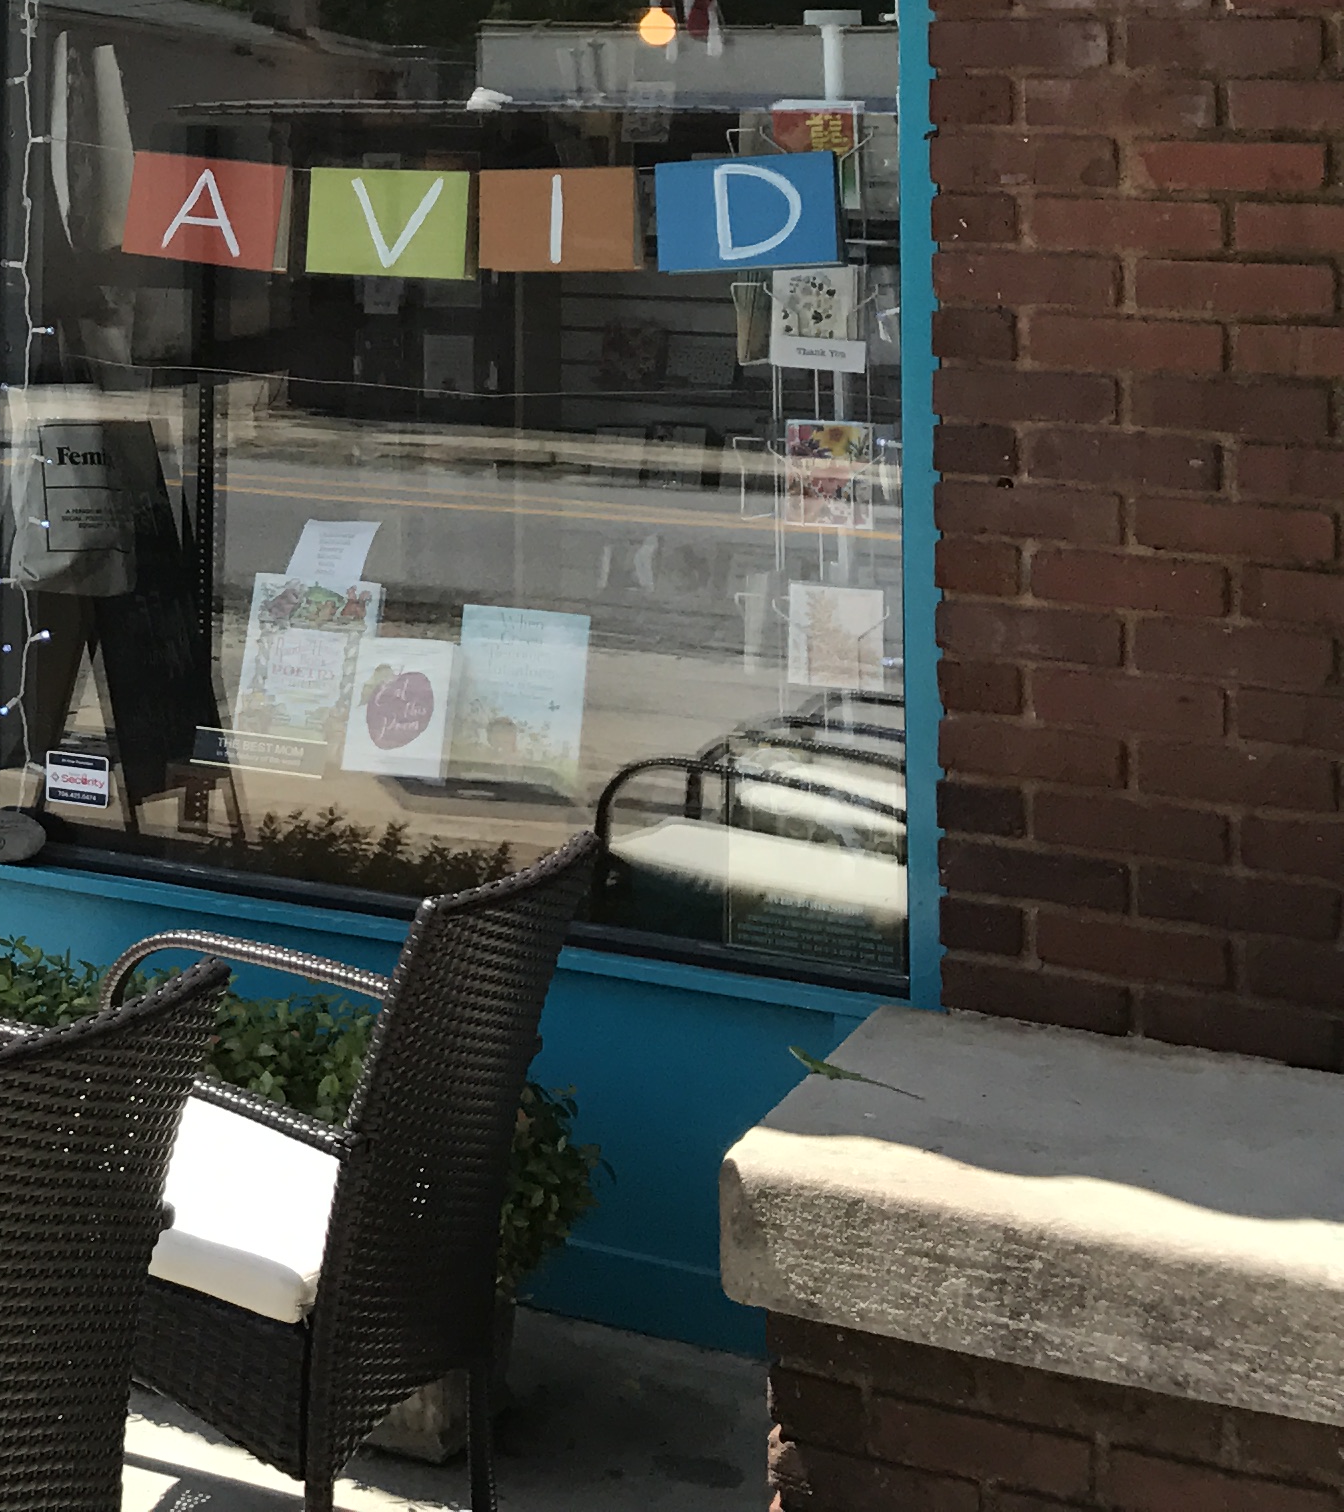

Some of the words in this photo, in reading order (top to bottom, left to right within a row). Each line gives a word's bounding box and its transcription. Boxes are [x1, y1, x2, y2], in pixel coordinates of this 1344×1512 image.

[242, 740, 273, 753] BEST
[274, 744, 305, 757] MOM
[60, 772, 106, 789] Security
